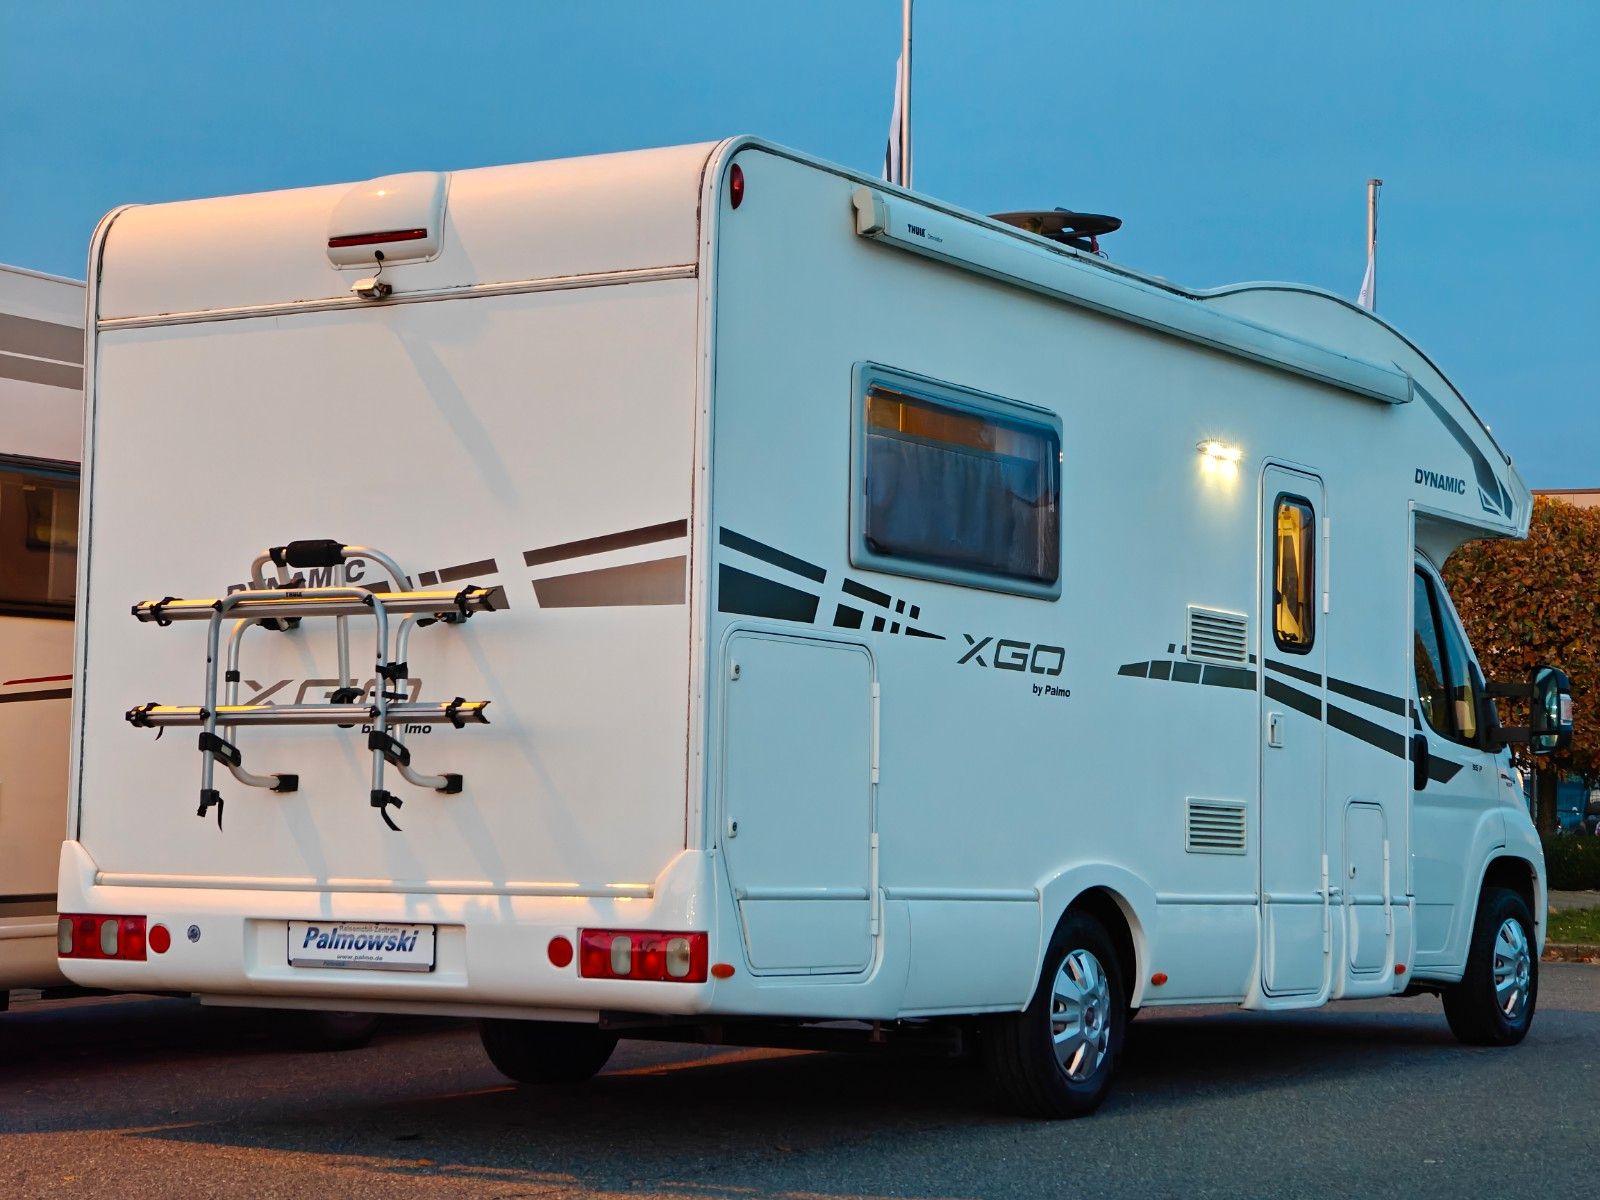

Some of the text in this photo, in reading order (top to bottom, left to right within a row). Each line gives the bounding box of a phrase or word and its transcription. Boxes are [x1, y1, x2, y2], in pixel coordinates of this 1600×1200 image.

[908, 224, 926, 237] THULE
[1415, 468, 1466, 495] DYNAMIC
[1032, 684, 1071, 697] by Palmo
[385, 723, 432, 734] Plmo
[302, 926, 419, 952] Palmowski
